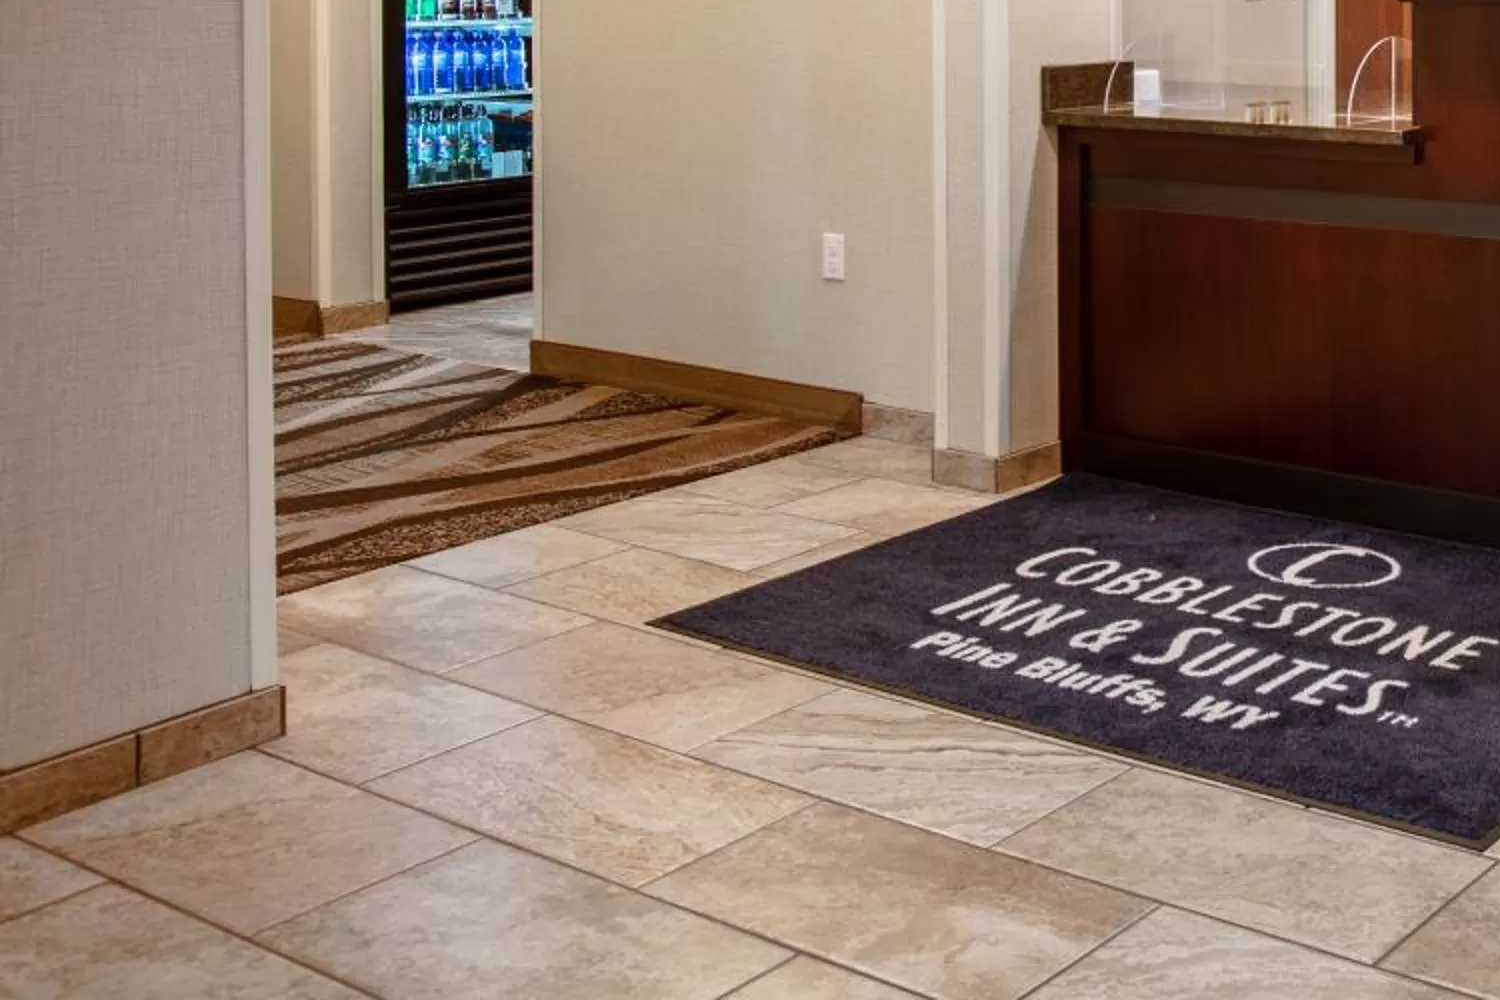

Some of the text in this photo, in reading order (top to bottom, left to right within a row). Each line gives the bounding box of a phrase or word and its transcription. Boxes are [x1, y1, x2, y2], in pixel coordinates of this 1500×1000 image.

[930, 582, 1088, 637] INN
[1067, 619, 1144, 653] &
[1131, 627, 1410, 716] SUITES
[1014, 546, 1499, 671] COBBLESTONE
[910, 631, 1281, 730] Pine Bluffs, WY
